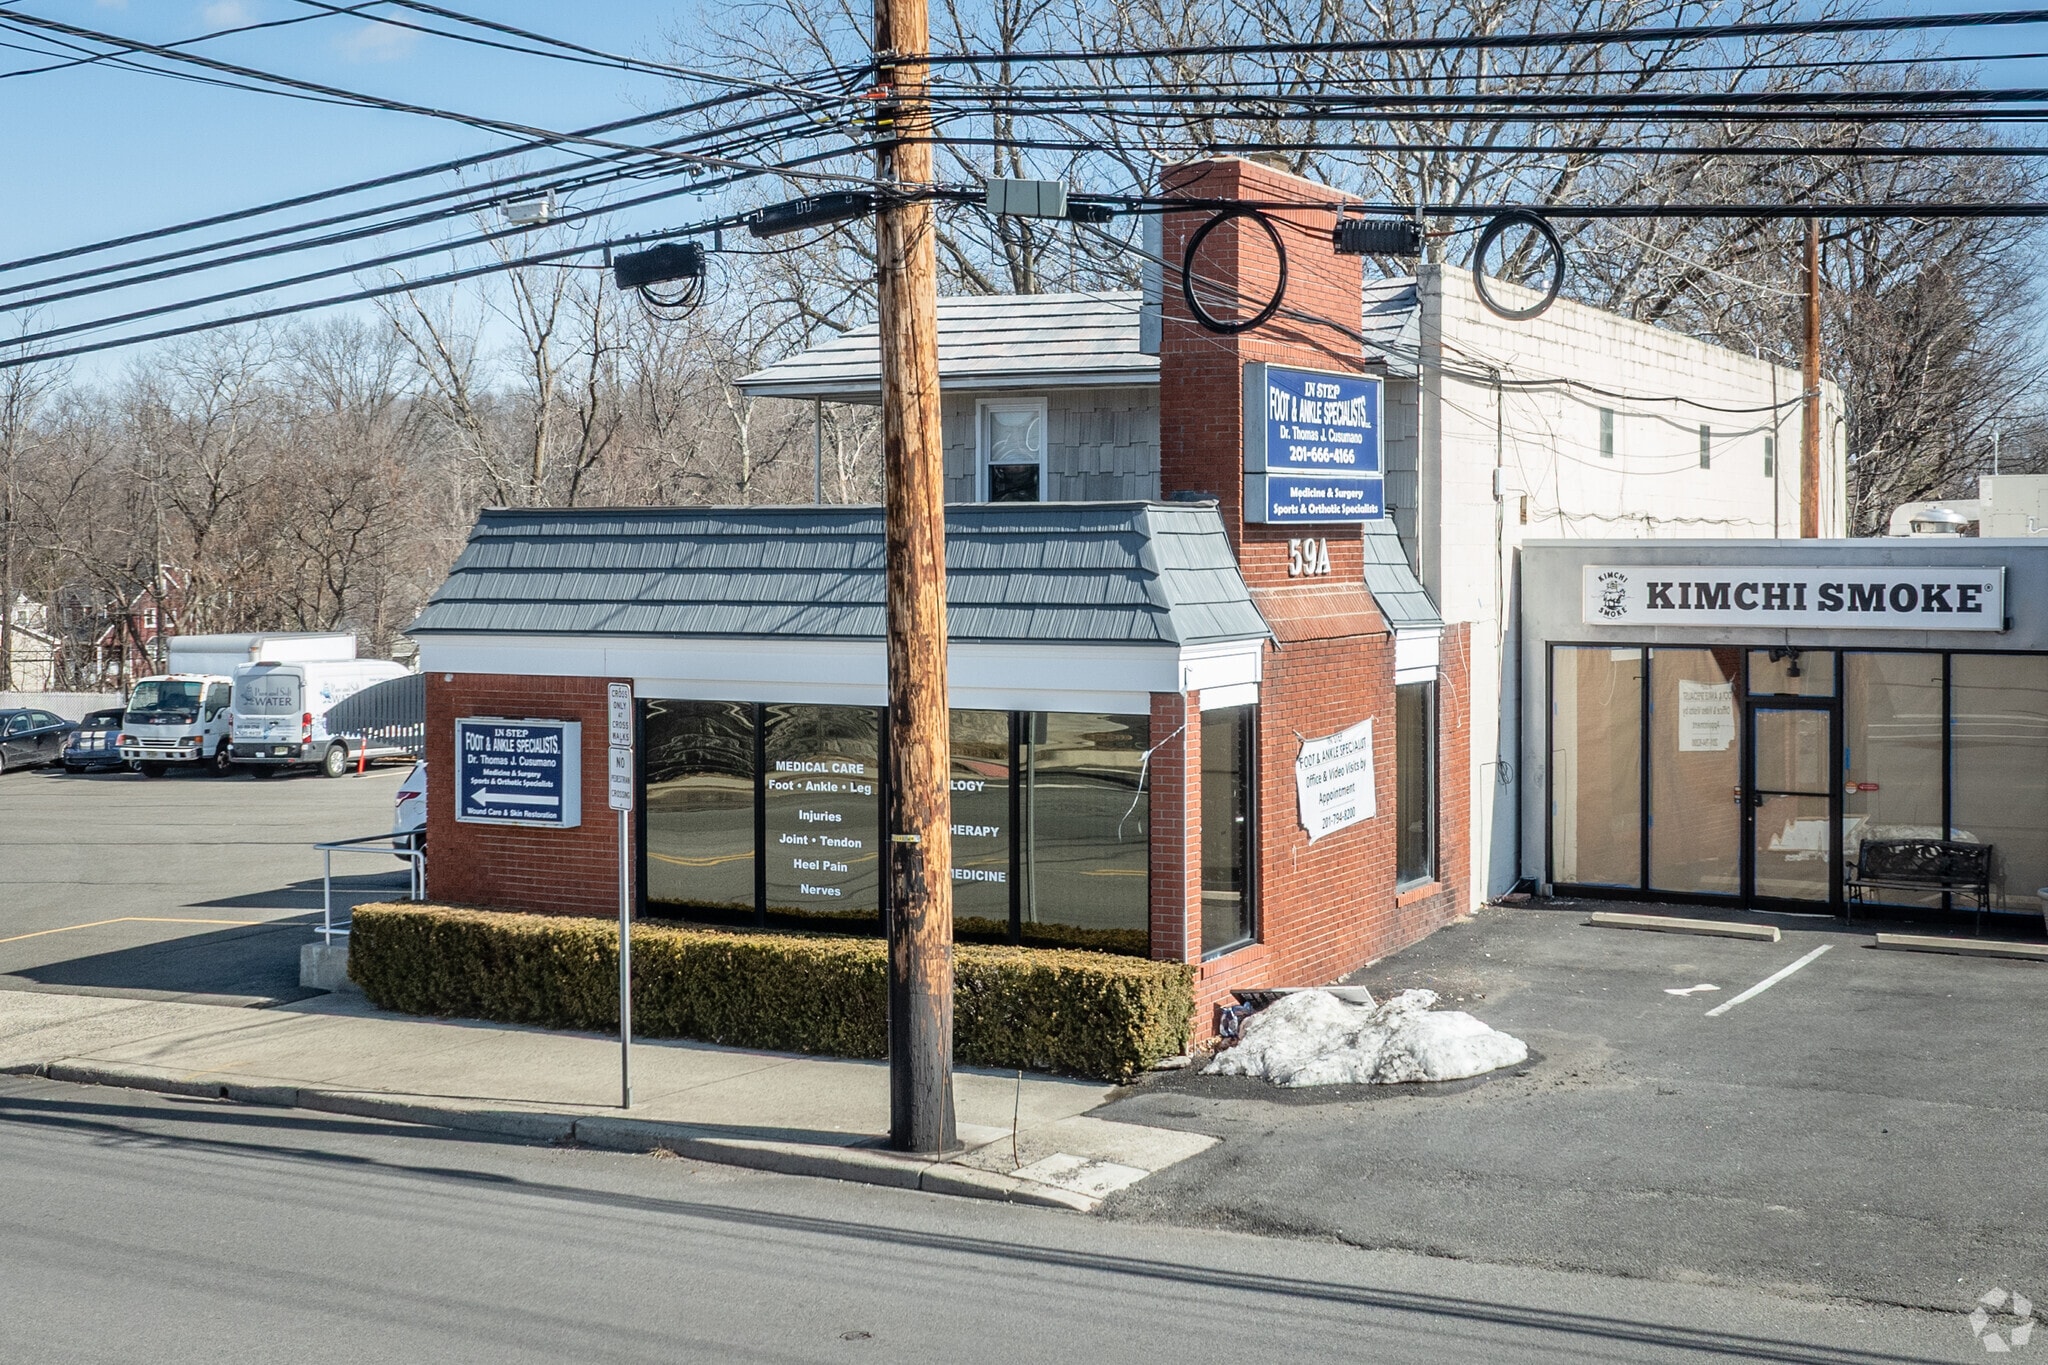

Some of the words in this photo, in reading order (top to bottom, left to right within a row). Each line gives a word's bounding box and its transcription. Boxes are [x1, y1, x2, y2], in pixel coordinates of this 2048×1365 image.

[1304, 382, 1316, 397] IN
[1316, 383, 1341, 400] STEP
[1270, 386, 1290, 422] FOOT
[1292, 396, 1298, 422] &
[1299, 398, 1322, 425] ANKLE
[1324, 396, 1366, 429] SPECIALISTS
[1280, 425, 1291, 440] Dr.
[1292, 426, 1319, 442] Thomas
[1320, 430, 1327, 442] J.
[1328, 428, 1363, 444] Cusumano
[1290, 446, 1355, 464] 201-666-4166
[1290, 487, 1326, 498] Medicine
[1327, 488, 1334, 498] &
[1334, 488, 1363, 500] Surgery
[1274, 504, 1299, 517] Sports
[1300, 504, 1307, 514] &
[1308, 504, 1341, 515] Orthotic
[1342, 504, 1379, 515] Specialists
[1288, 538, 1331, 575] 59A
[1598, 572, 1628, 583] KIMCHI
[1646, 582, 1807, 611] KIMCHI
[1598, 607, 1628, 618] SMOKE
[612, 690, 628, 699] CROSS
[254, 697, 292, 706] WATER
[613, 701, 627, 710] ONLY
[612, 720, 629, 730] CROSS
[494, 728, 505, 737] IN
[505, 729, 529, 738] STEP
[612, 732, 629, 741] WALKS
[465, 732, 484, 751] FOOT
[486, 737, 491, 751] &
[493, 738, 515, 752] ANKLE
[516, 735, 558, 754] SPECIALISTS
[468, 754, 479, 764] Dr.
[480, 755, 508, 766] Thomas
[510, 756, 517, 766] J.
[519, 756, 557, 768] Cusumano
[616, 757, 625, 769] NO
[1300, 753, 1315, 769] FOOT
[1317, 753, 1321, 764] &
[1322, 746, 1339, 762] ANKLE
[483, 768, 511, 777] Medicine
[518, 770, 541, 779] Surgery
[776, 761, 829, 773] MEDICAL
[832, 763, 864, 774] CARE
[1306, 774, 1322, 788] Office
[1323, 771, 1328, 781] &
[1328, 766, 1344, 781] Video
[1345, 760, 1360, 775] Visits
[1360, 758, 1367, 772] by
[471, 777, 490, 786] Sports
[497, 778, 522, 786] Orthotic
[523, 780, 554, 788] Specialists
[768, 780, 794, 790] Foot
[805, 781, 838, 792] Ankle
[850, 782, 872, 795] Leg
[1319, 782, 1356, 806] Appointment
[467, 807, 487, 815] Wound
[488, 808, 502, 816] Care
[510, 809, 523, 817] Skin
[524, 810, 558, 819] Restoration
[799, 810, 842, 823] Injuries
[779, 834, 809, 845] Joint
[820, 836, 862, 848] Tendon
[793, 859, 820, 870] Heel
[822, 861, 848, 872] Pain
[800, 884, 841, 896] Nerves
